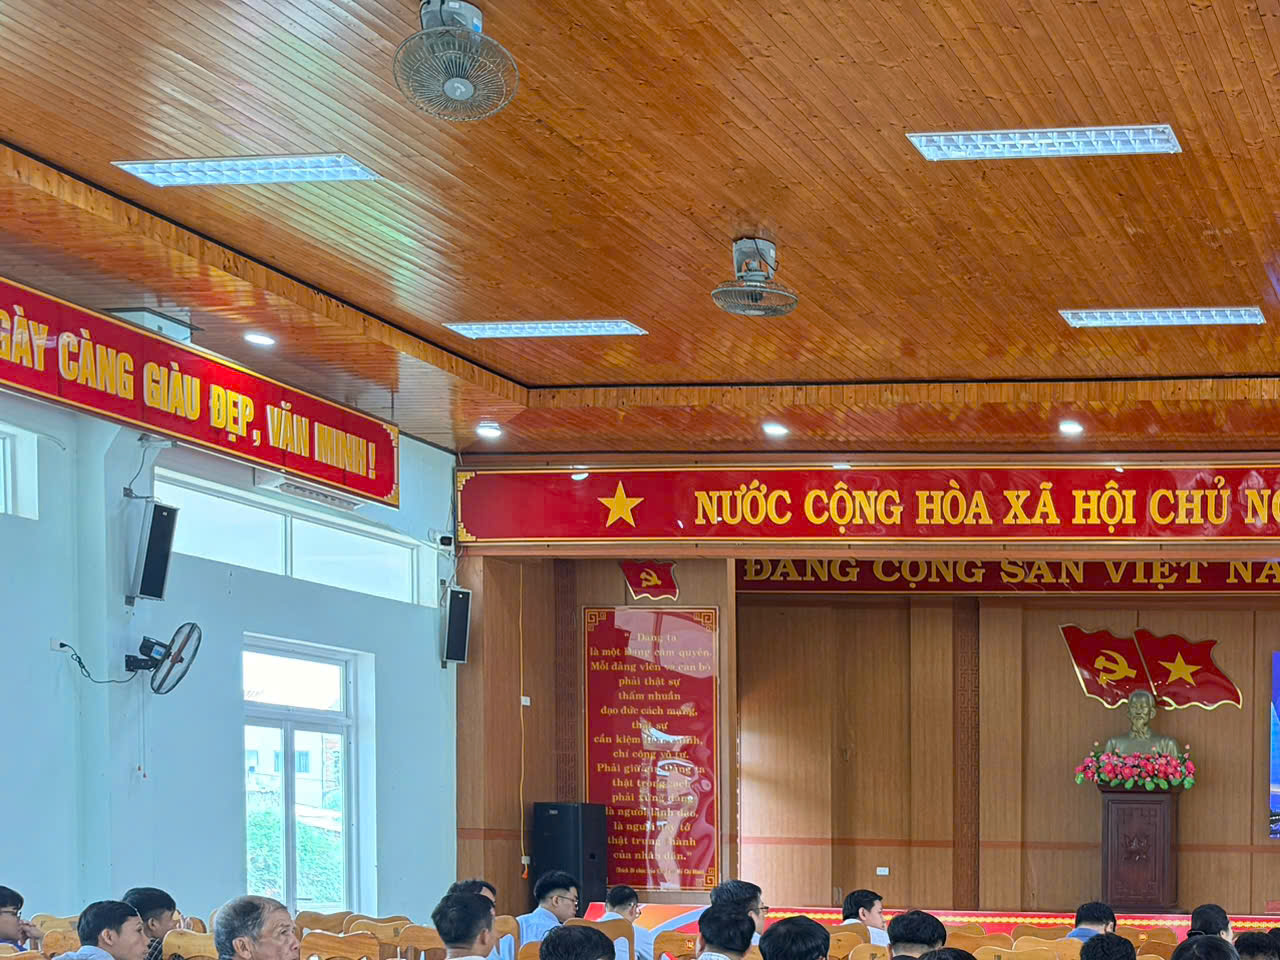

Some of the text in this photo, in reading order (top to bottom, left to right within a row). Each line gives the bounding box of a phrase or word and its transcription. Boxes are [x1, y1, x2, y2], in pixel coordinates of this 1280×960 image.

[58, 328, 135, 400] CÀNG
[143, 361, 201, 421] GIÀU
[209, 384, 261, 446] ĐẸP,
[266, 401, 310, 458] VĂN
[314, 422, 376, 480] MINH!
[694, 479, 792, 526] NƯỚC
[804, 481, 904, 533] CỘNG
[915, 482, 991, 525] HÒA
[1003, 482, 1062, 525] XÃ
[1071, 480, 1137, 533] HỘI
[1149, 476, 1229, 525] CHỦ
